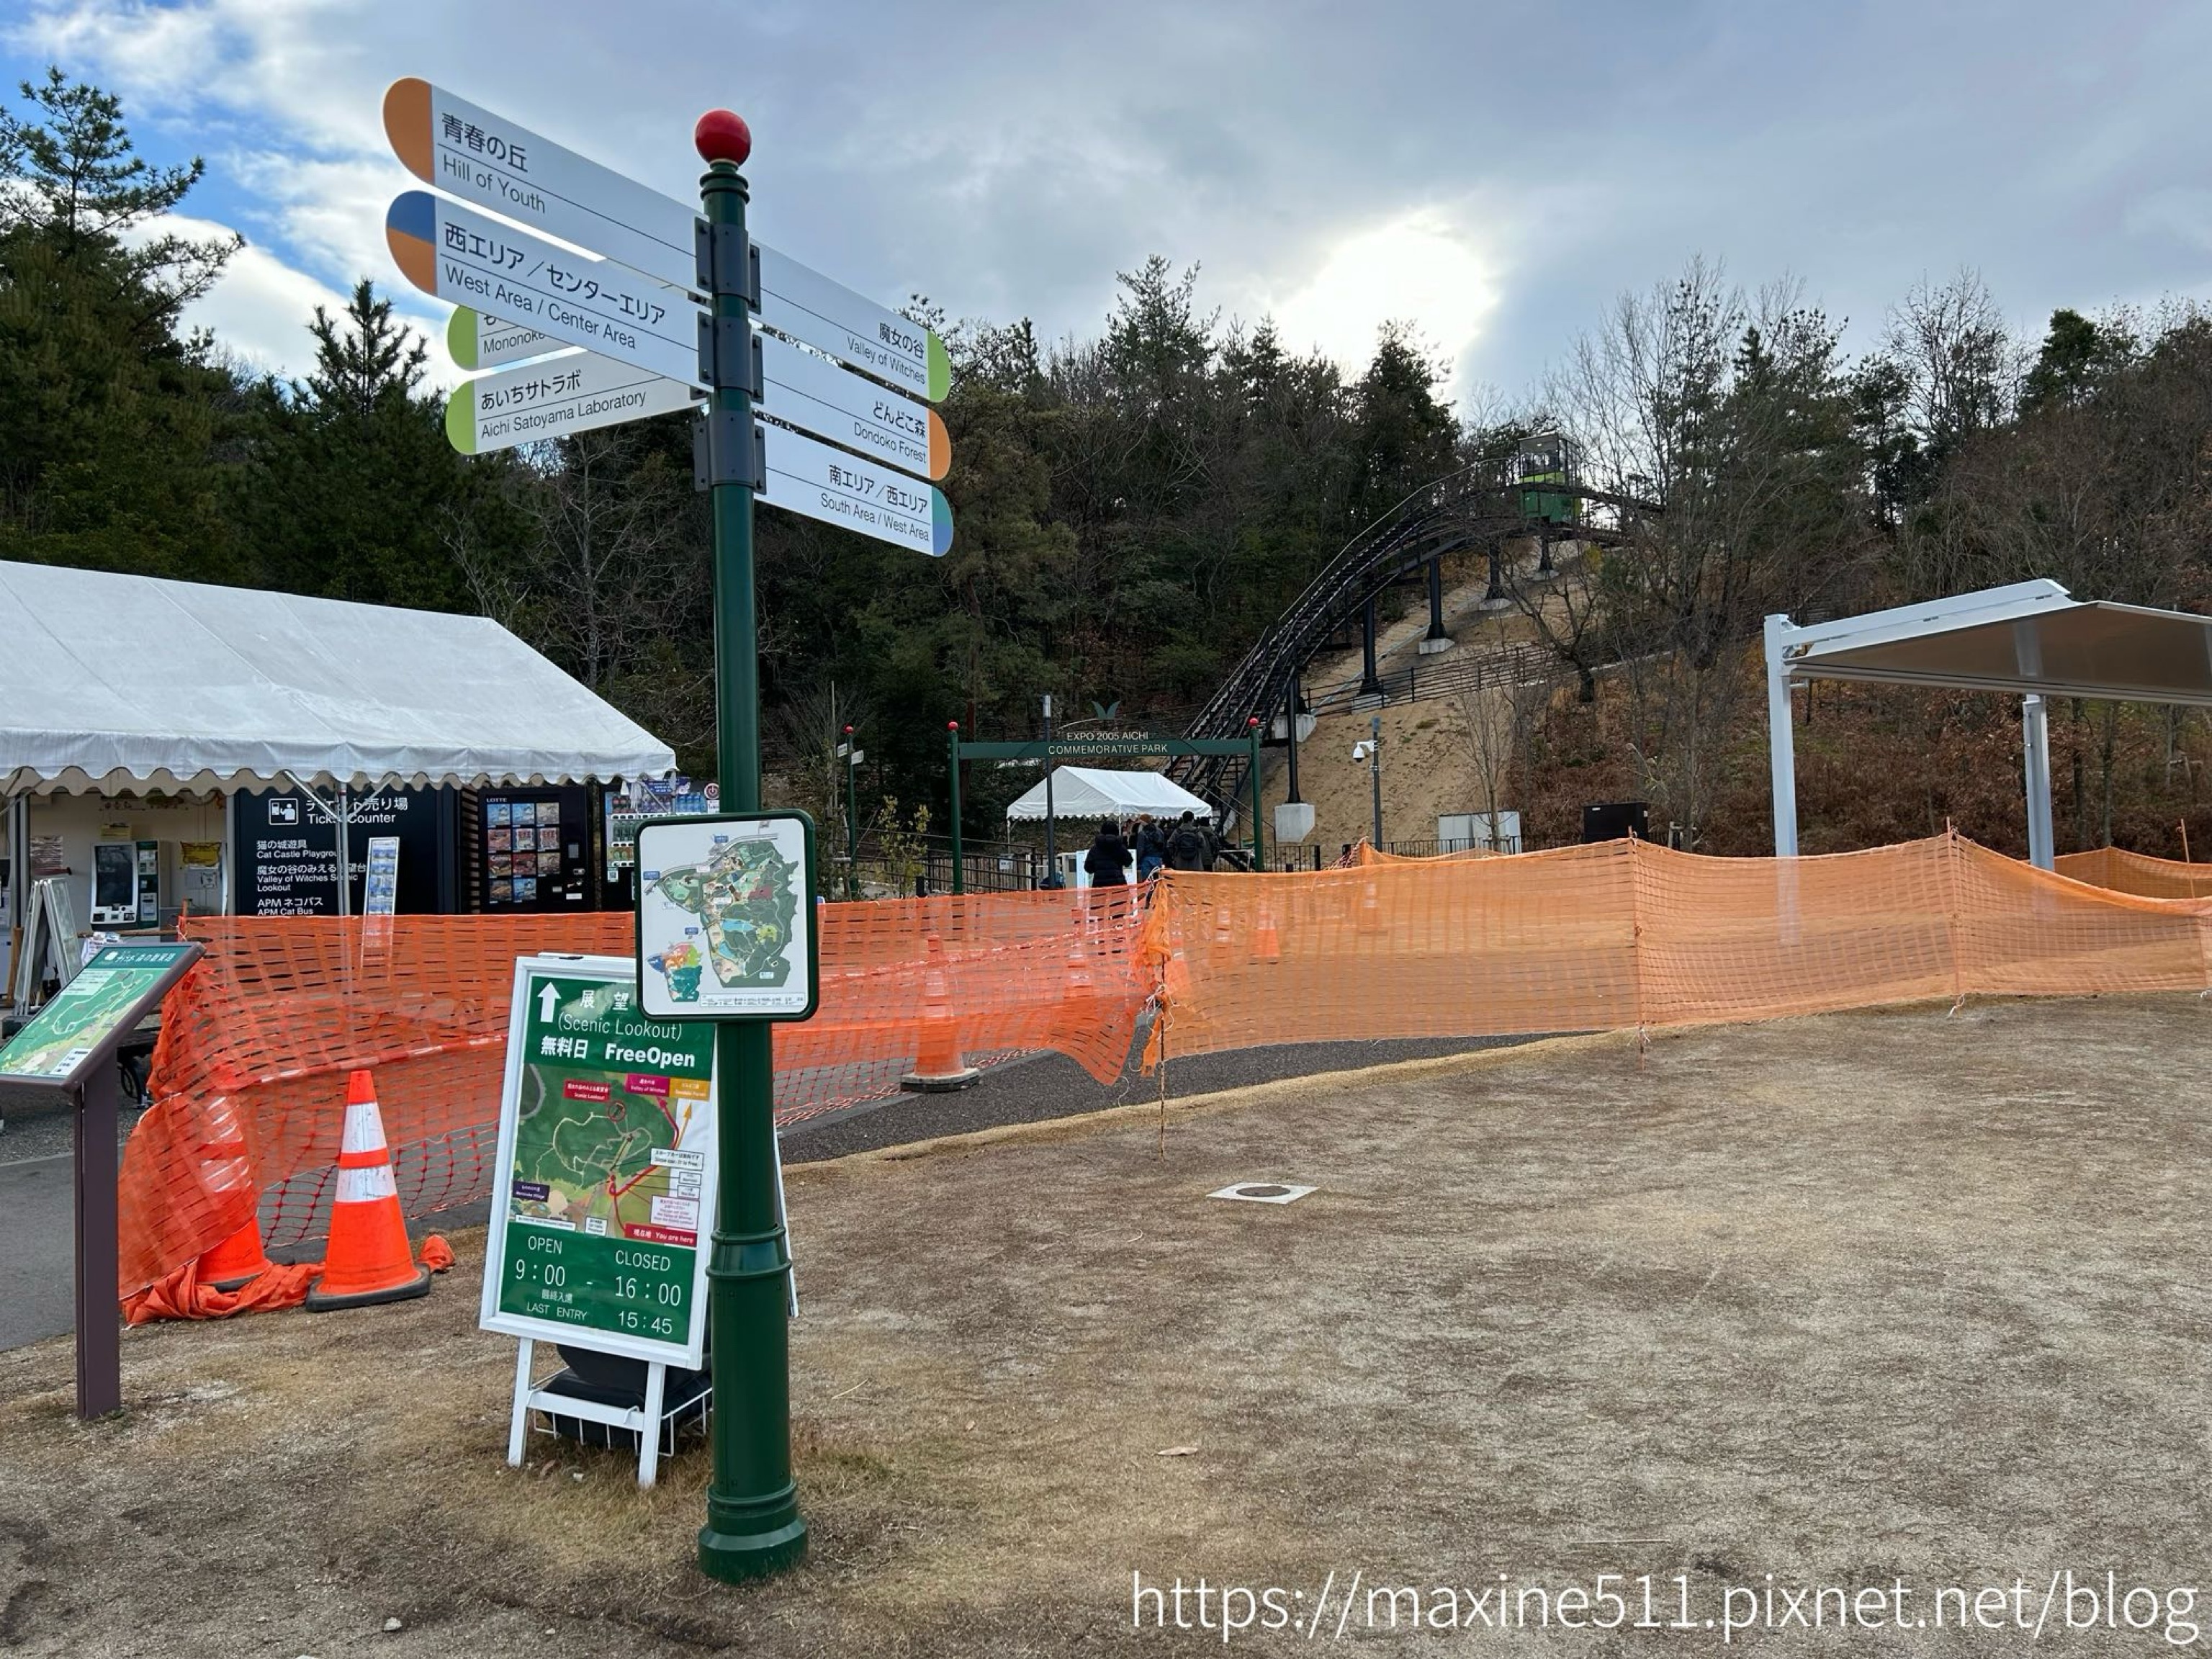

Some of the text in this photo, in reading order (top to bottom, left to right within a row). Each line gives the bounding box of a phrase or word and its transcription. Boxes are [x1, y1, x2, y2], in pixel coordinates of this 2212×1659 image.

[441, 112, 529, 173] 青春の丘
[444, 154, 546, 214] Hill of Youth
[445, 264, 636, 349] West Area / Center Area
[879, 322, 925, 359] 魔女の谷
[847, 336, 925, 385] Valley of Witches
[481, 369, 582, 410] あいちサトラボ
[481, 391, 647, 439] Aichi Satoyama Laboratory
[873, 400, 925, 438] どんどこ森
[854, 422, 927, 464] Dondoko Forest
[821, 492, 929, 541] South Area / West Area
[1048, 744, 1168, 755] COMMEMORATIVE PARK
[1066, 731, 1148, 742] EXPO 2005 AICHI
[349, 813, 396, 824] Counter
[256, 840, 307, 850] 猫の城遊具
[257, 863, 367, 876] 魔女の谷のみえる望台
[257, 875, 283, 884] Valley
[257, 898, 282, 907] APM
[558, 1012, 683, 1041] (Scenic Lookout)
[540, 1035, 696, 1068] 無料日 FreeOpen
[528, 1236, 670, 1272] OPEN CLOSED
[527, 1302, 550, 1315] LAST
[557, 1305, 588, 1321] ENTRY
